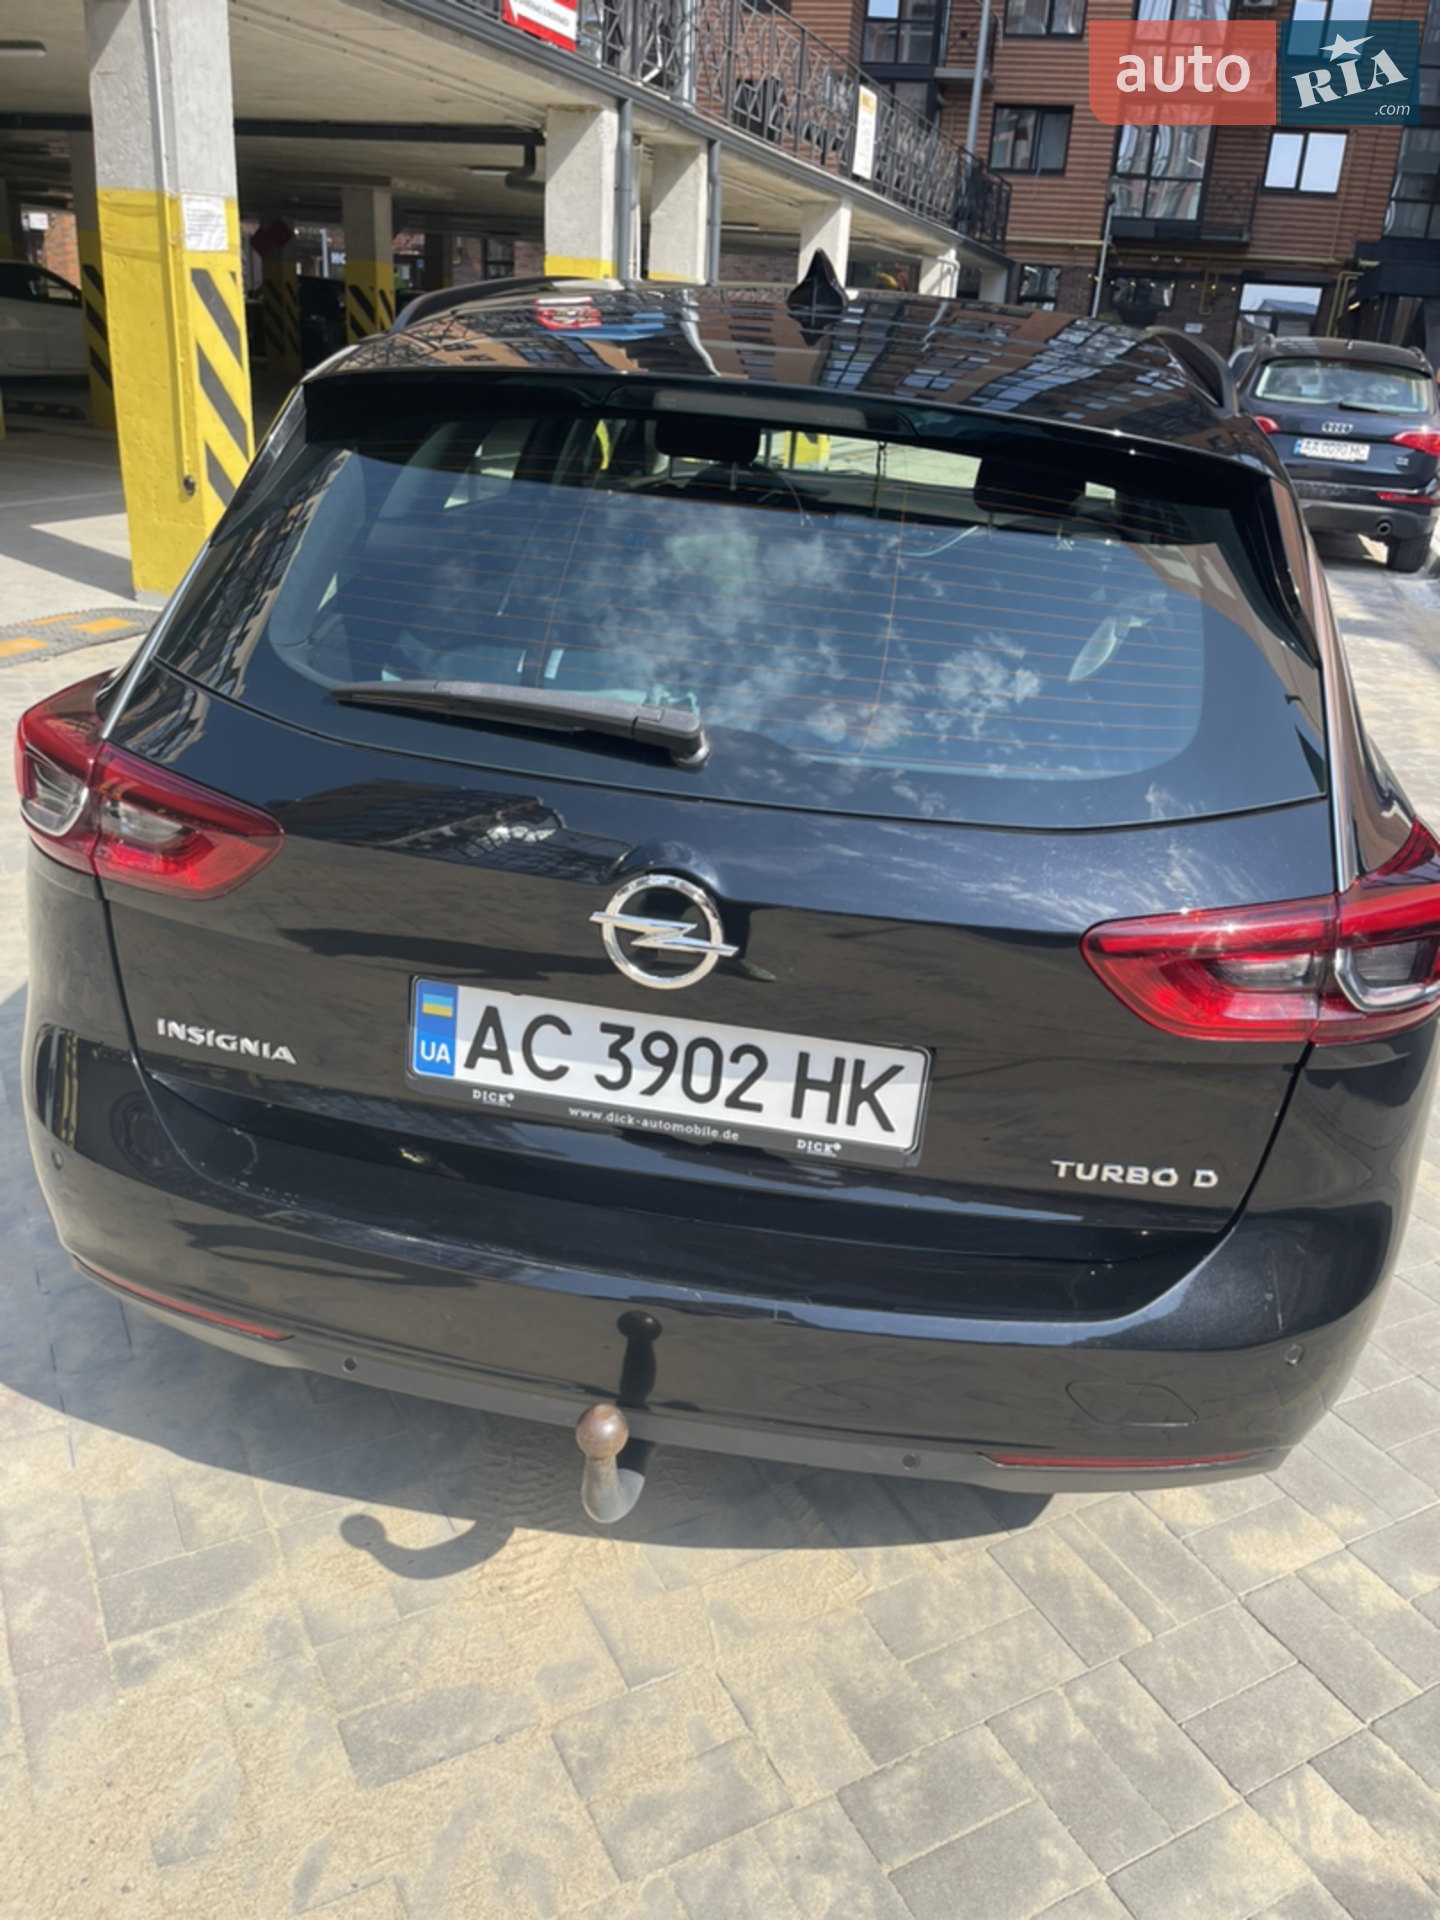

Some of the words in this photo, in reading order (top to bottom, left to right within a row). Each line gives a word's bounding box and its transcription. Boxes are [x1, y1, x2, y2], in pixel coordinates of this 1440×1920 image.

[157, 1018, 297, 1065] INSIGNIA
[420, 1040, 451, 1064] UA
[464, 1005, 573, 1081] AC
[595, 1022, 768, 1113] 3902
[791, 1052, 905, 1133] HK
[472, 1089, 509, 1103] DICK
[568, 1106, 740, 1142] www.dick-automobile.de
[797, 1139, 834, 1154] DICK
[1051, 1160, 1179, 1187] TURBO
[1193, 1169, 1218, 1188] D
